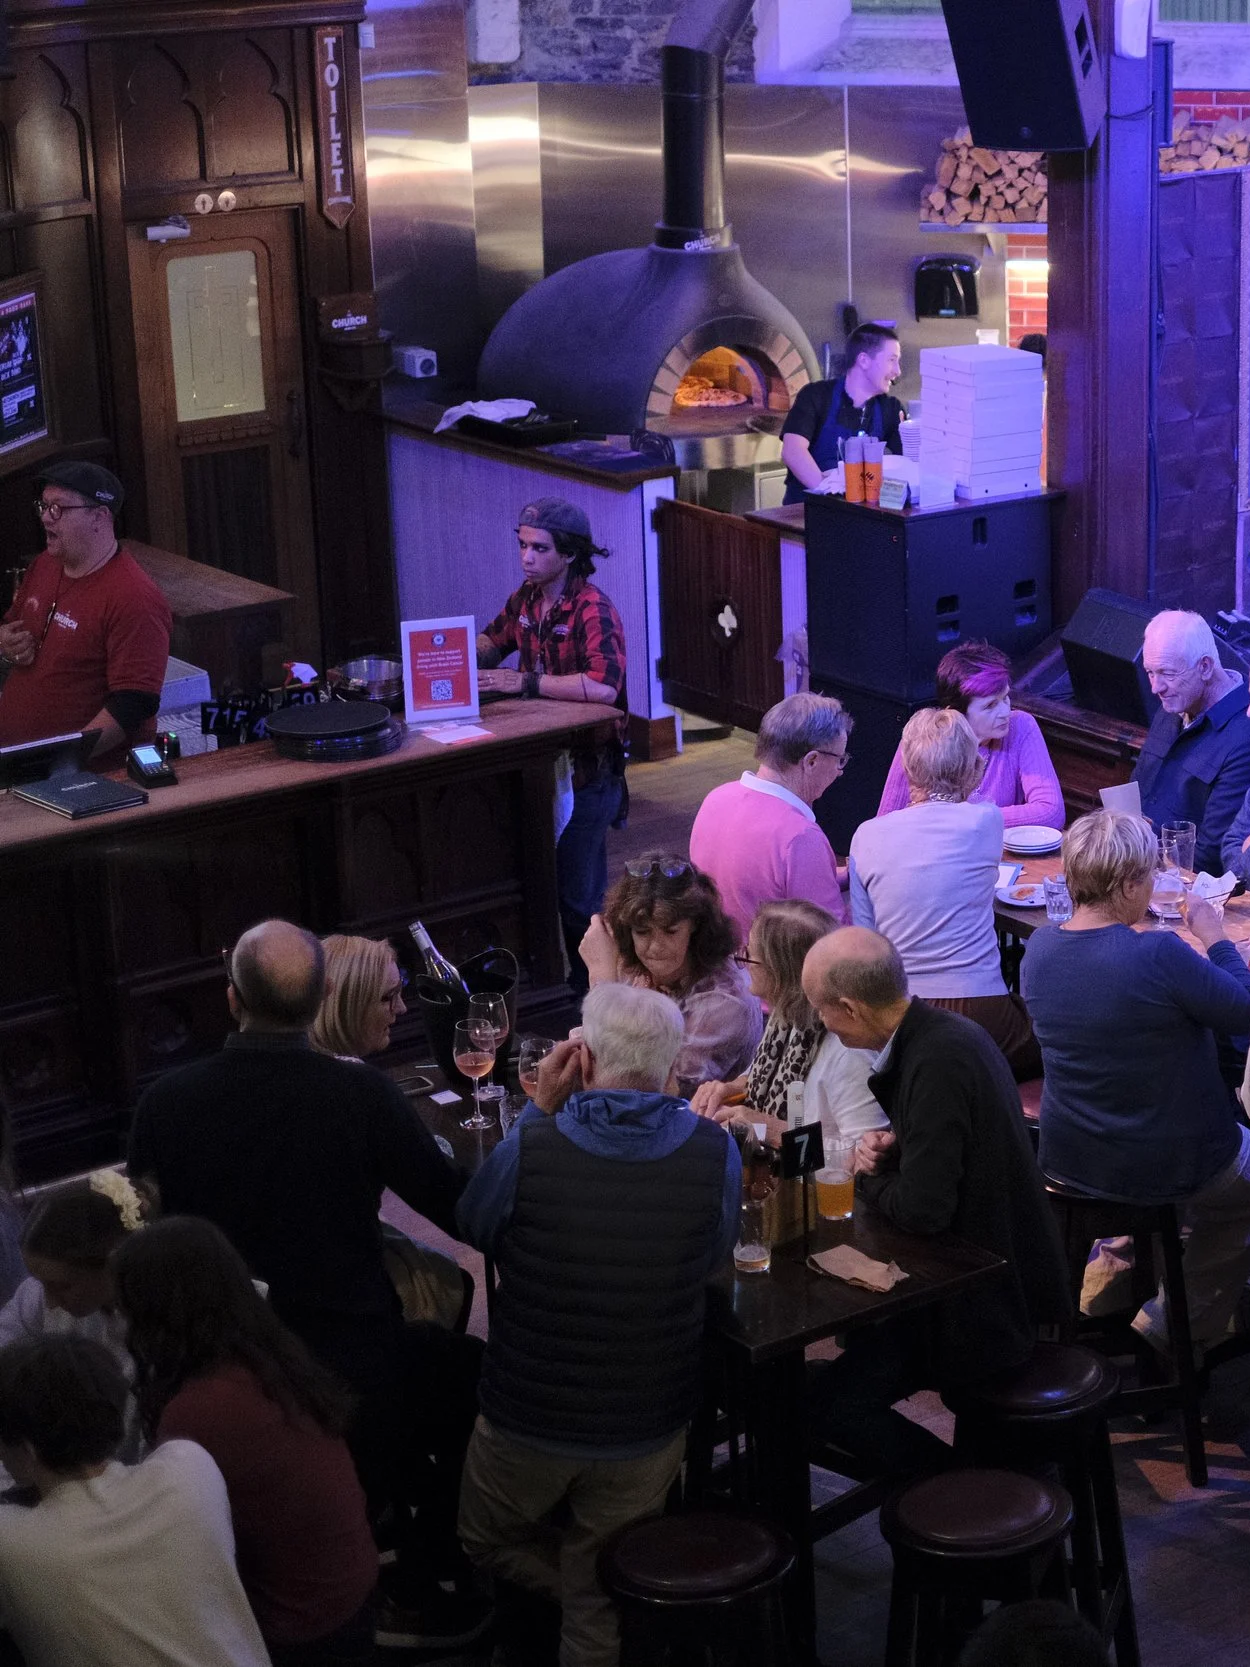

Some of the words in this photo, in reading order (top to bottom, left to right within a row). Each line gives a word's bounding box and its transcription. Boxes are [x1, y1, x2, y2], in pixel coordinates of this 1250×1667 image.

[323, 36, 345, 193] TOILET
[331, 314, 368, 329] CHURCH
[205, 706, 220, 730] 7
[794, 1132, 810, 1169] 7
